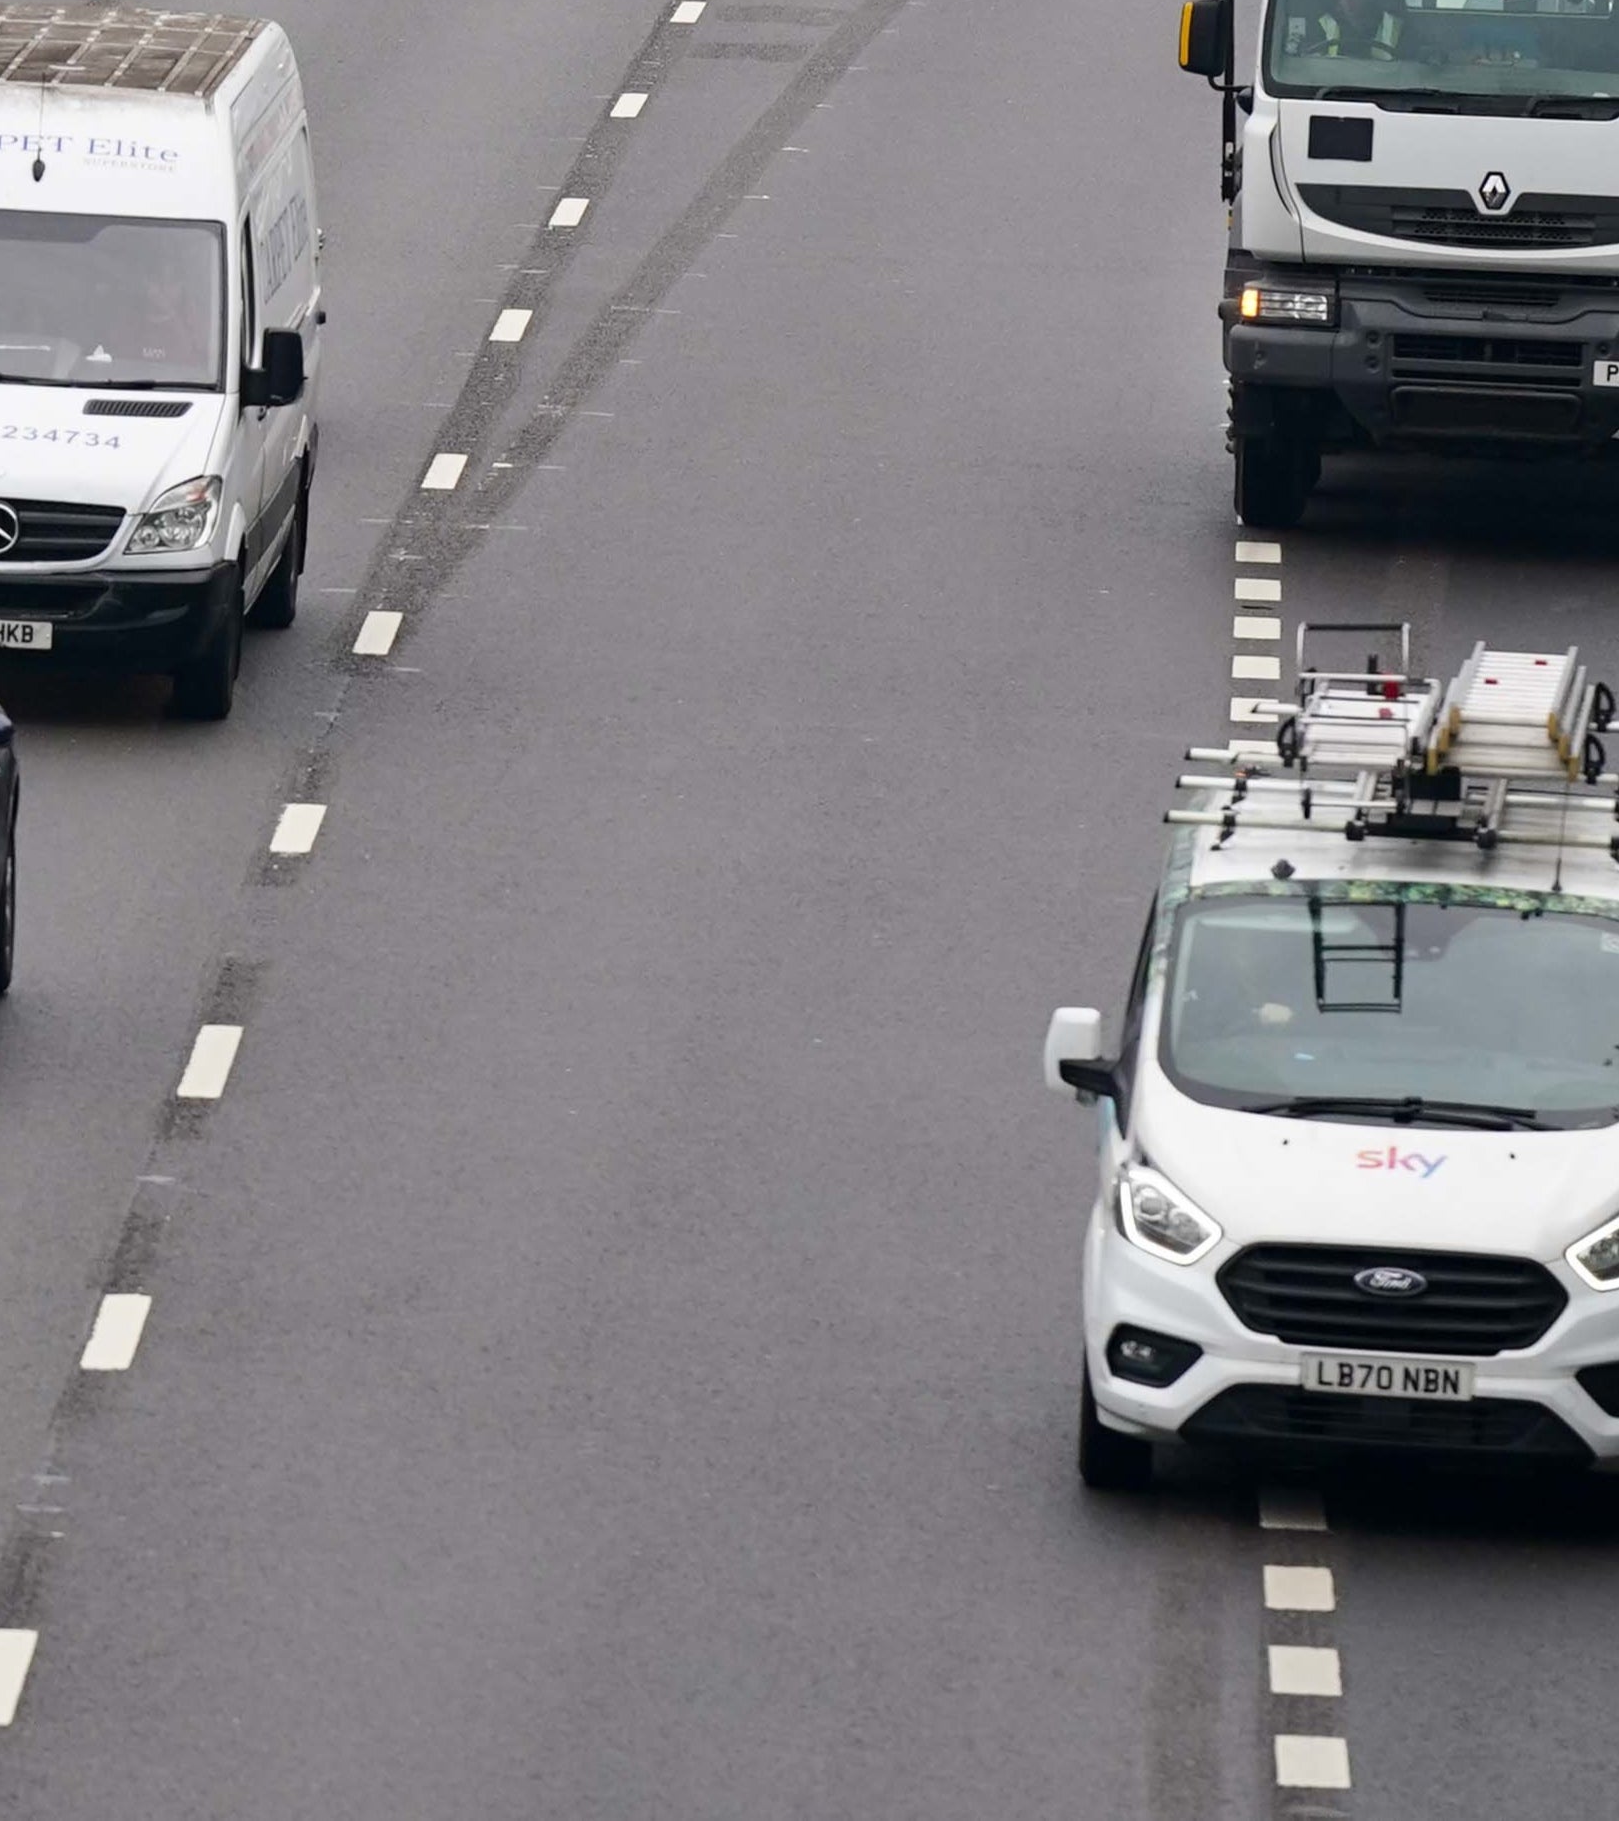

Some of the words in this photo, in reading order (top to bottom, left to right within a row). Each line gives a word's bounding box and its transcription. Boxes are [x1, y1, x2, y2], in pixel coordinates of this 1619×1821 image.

[88, 137, 179, 163] Elite
[1, 424, 122, 450] 234734
[1356, 1146, 1448, 1179] sky
[1317, 1360, 1395, 1392] LB70
[1403, 1364, 1462, 1396] NBN
